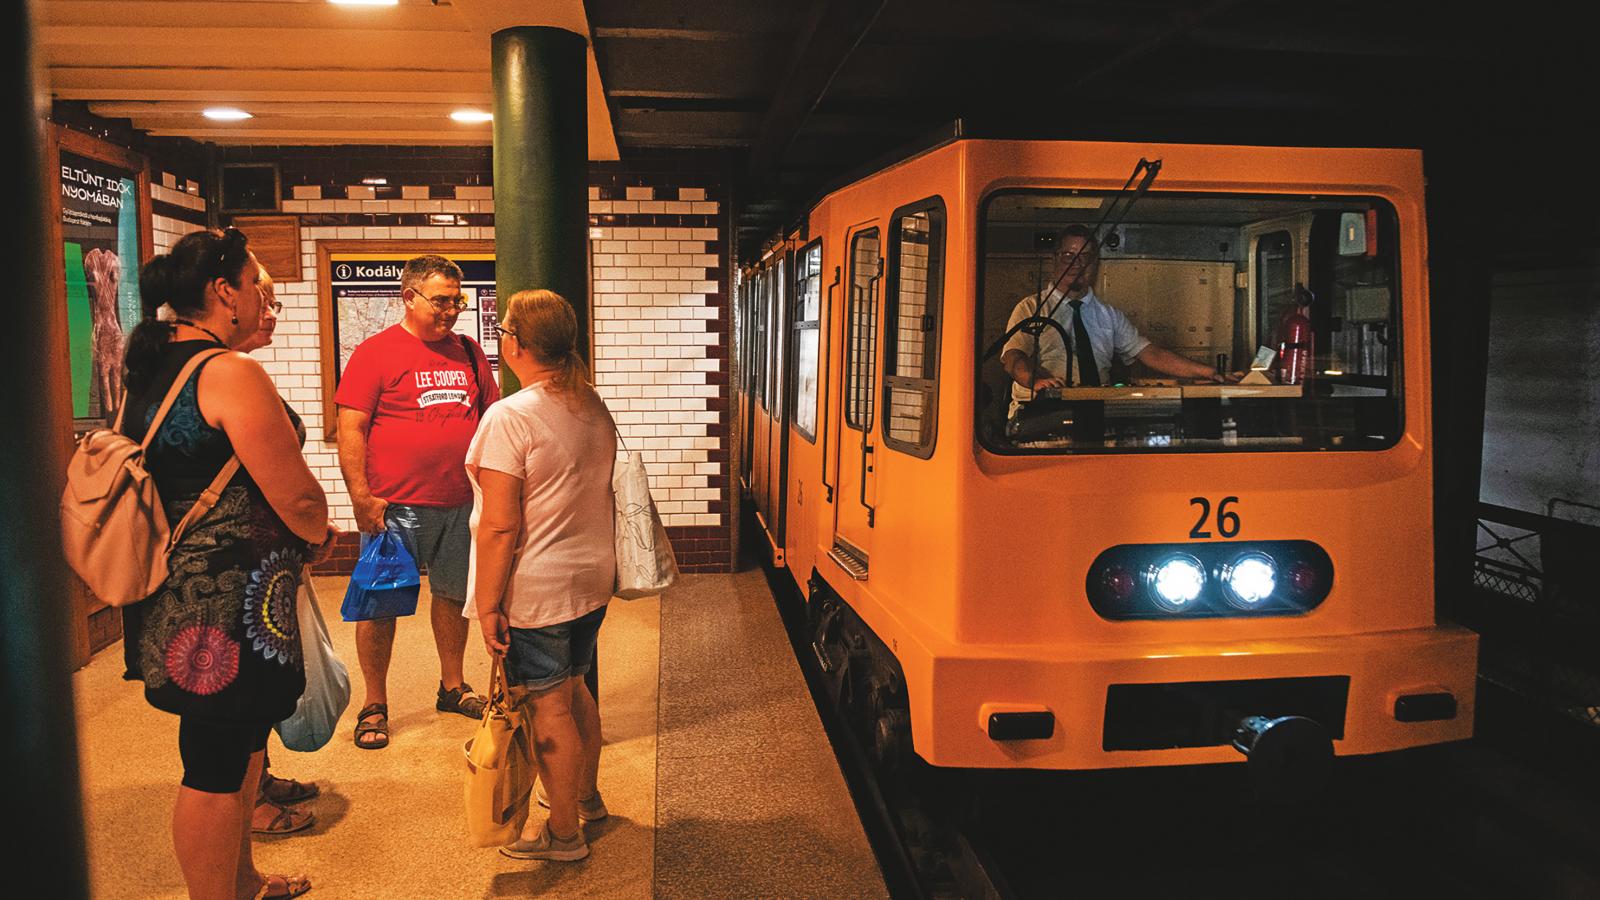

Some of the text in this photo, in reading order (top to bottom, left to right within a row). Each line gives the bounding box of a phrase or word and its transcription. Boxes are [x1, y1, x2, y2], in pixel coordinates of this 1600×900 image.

[62, 184, 124, 209] NYOMÁBAN
[356, 265, 404, 280] Kodály
[415, 370, 468, 388] LEE COOPER
[1189, 495, 1241, 539] 26
